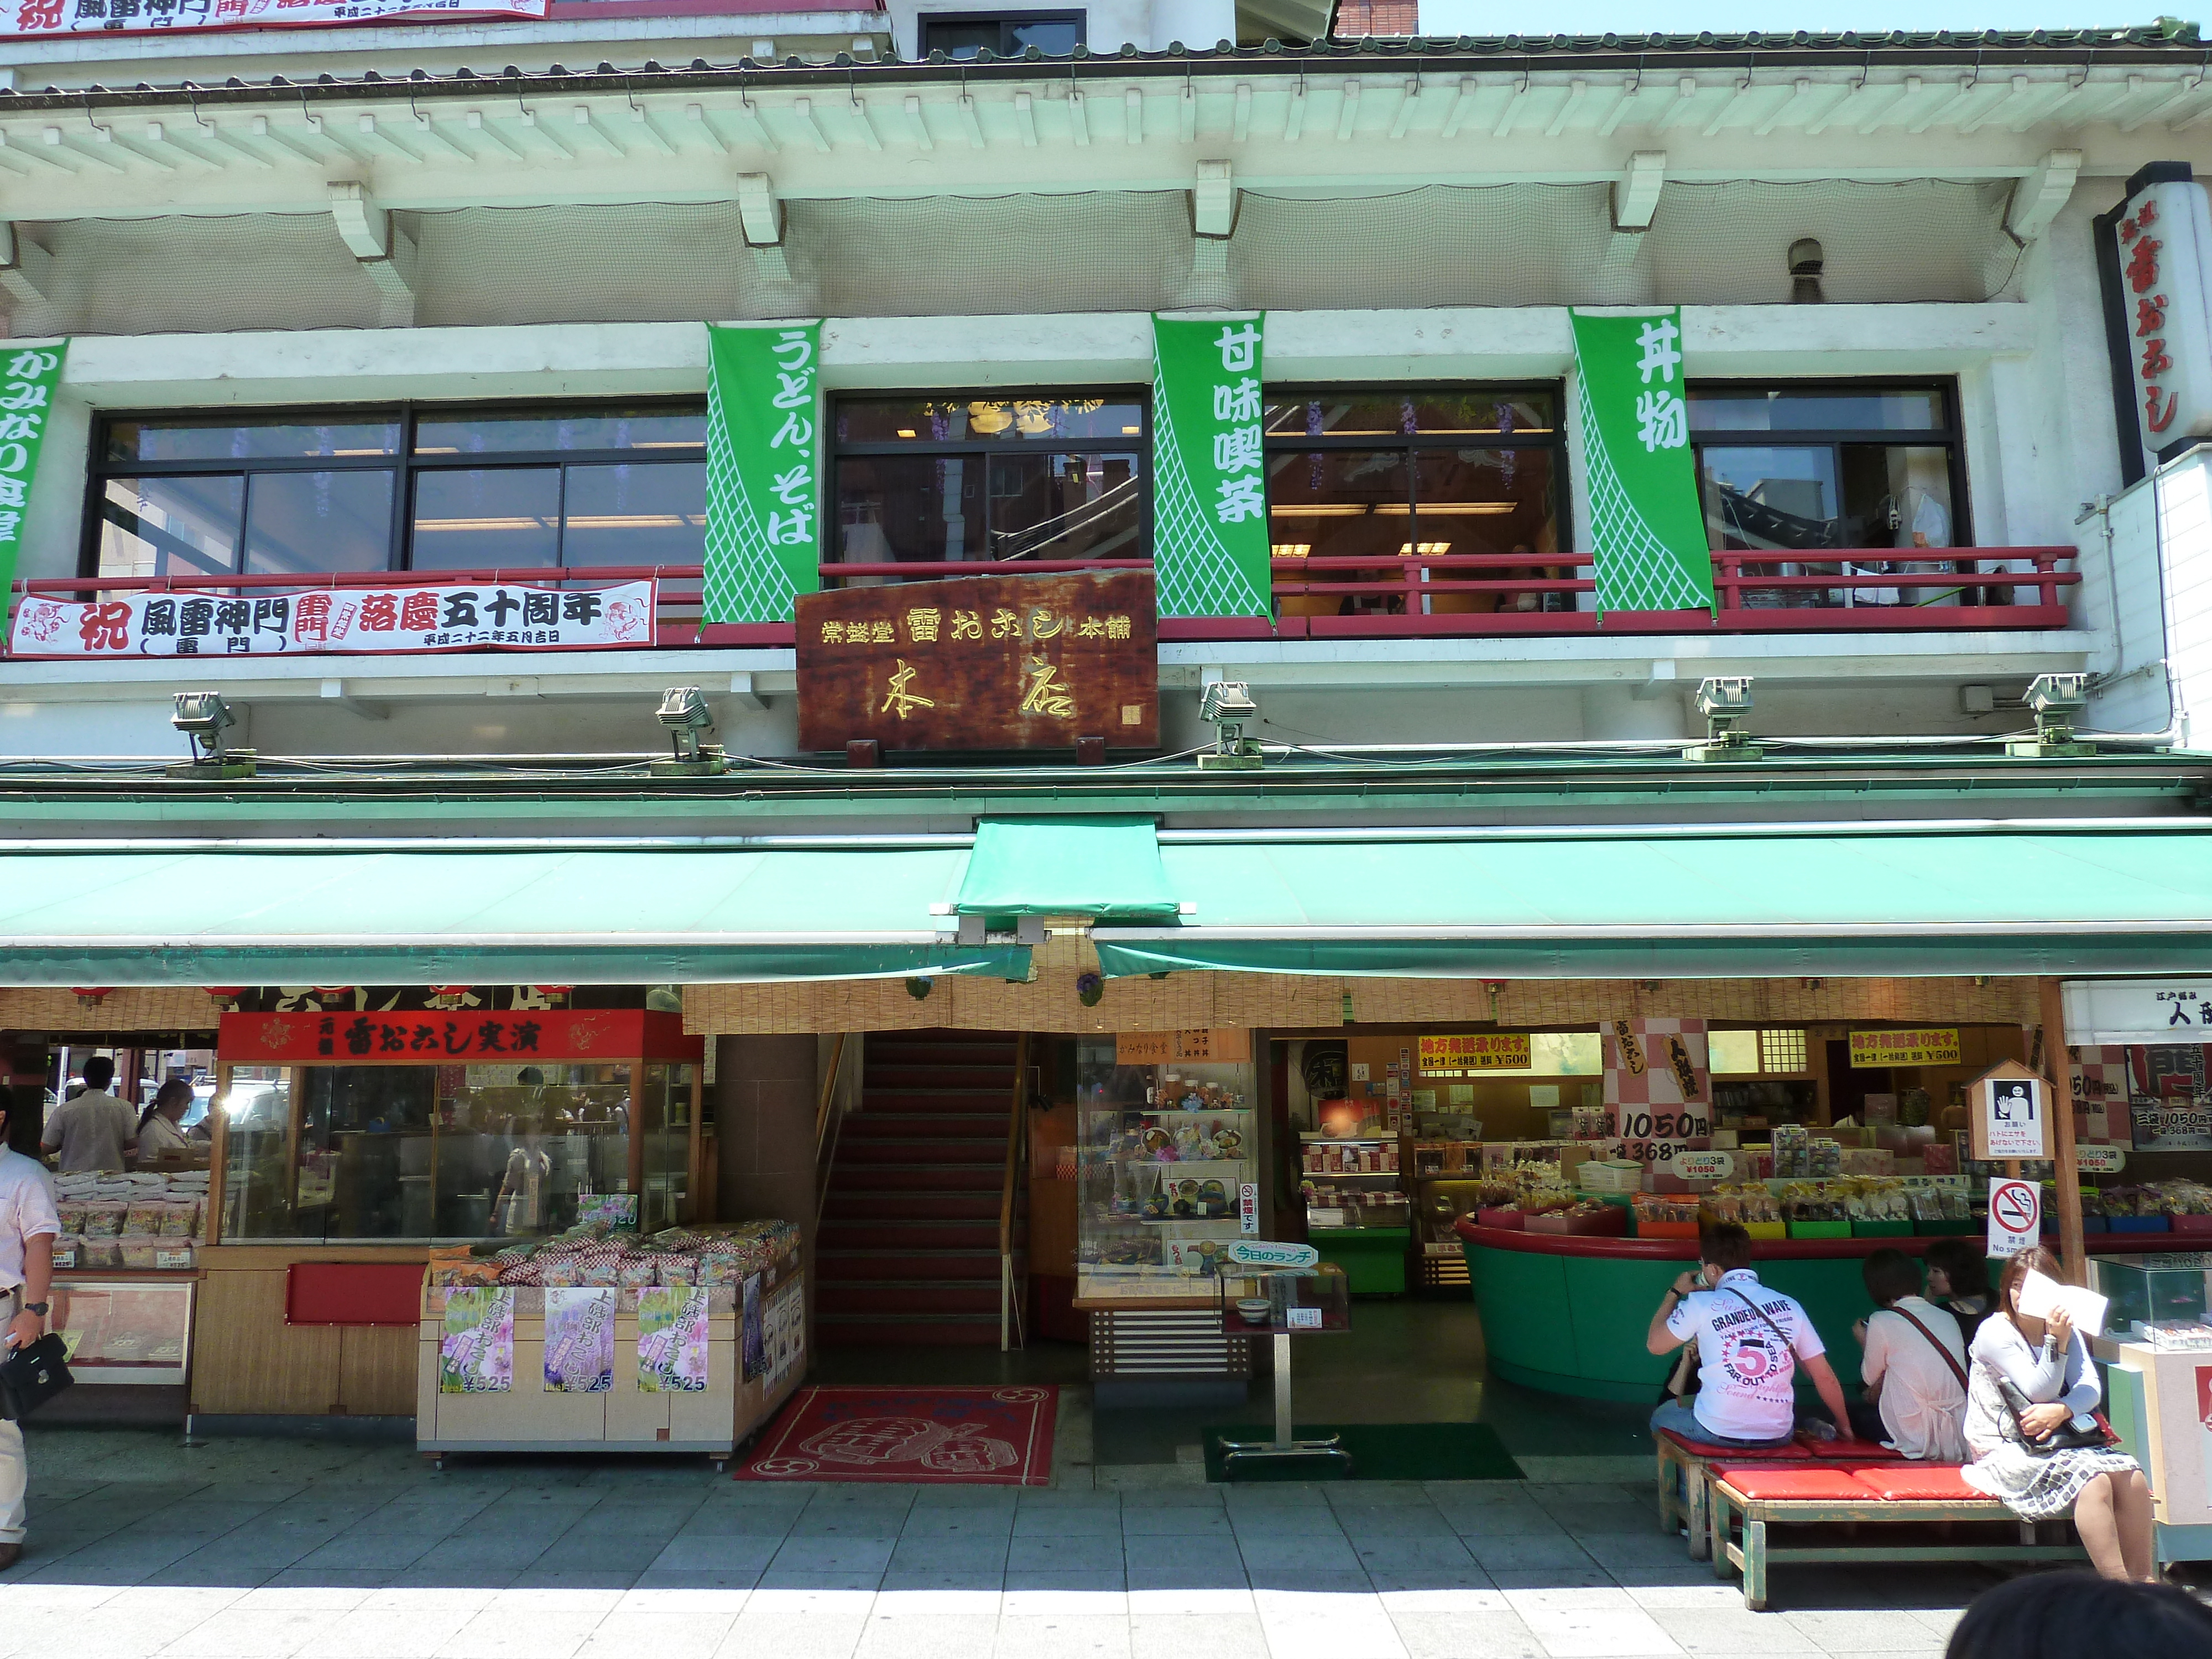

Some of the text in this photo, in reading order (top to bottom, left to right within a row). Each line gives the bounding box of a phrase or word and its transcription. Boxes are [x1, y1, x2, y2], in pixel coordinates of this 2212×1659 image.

[1635, 319, 1687, 452] 丼物
[1213, 323, 1264, 523] 甘味喫茶
[768, 331, 814, 546] うどん、そば
[79, 601, 133, 651] 祝
[141, 597, 289, 636] 風雷神門
[294, 593, 333, 643] 雷門
[422, 629, 560, 646] 平成二十二年五月吉日
[344, 1016, 544, 1056] 雷おこし実演
[1421, 1036, 1529, 1054] 地方発送承ります。
[1495, 1055, 1527, 1065] ¥500
[2077, 1150, 2117, 1159] りどり3袋
[1242, 1198, 1254, 1230] 禁煙です
[1992, 1244, 2004, 1252] No
[2007, 1235, 2026, 1245] 禁煙
[1236, 1245, 1311, 1263] 今日のランチ
[1711, 1307, 1760, 1332] GRANDEU
[1761, 1300, 1792, 1316] WAVE
[1724, 1363, 1742, 1382] FAR
[1742, 1376, 1765, 1386] OUT
[1765, 1340, 1778, 1363] SEA
[1734, 1347, 1767, 1376] 5
[463, 1375, 511, 1392] ¥525
[564, 1375, 612, 1392] ¥525
[659, 1375, 706, 1392] ¥525
